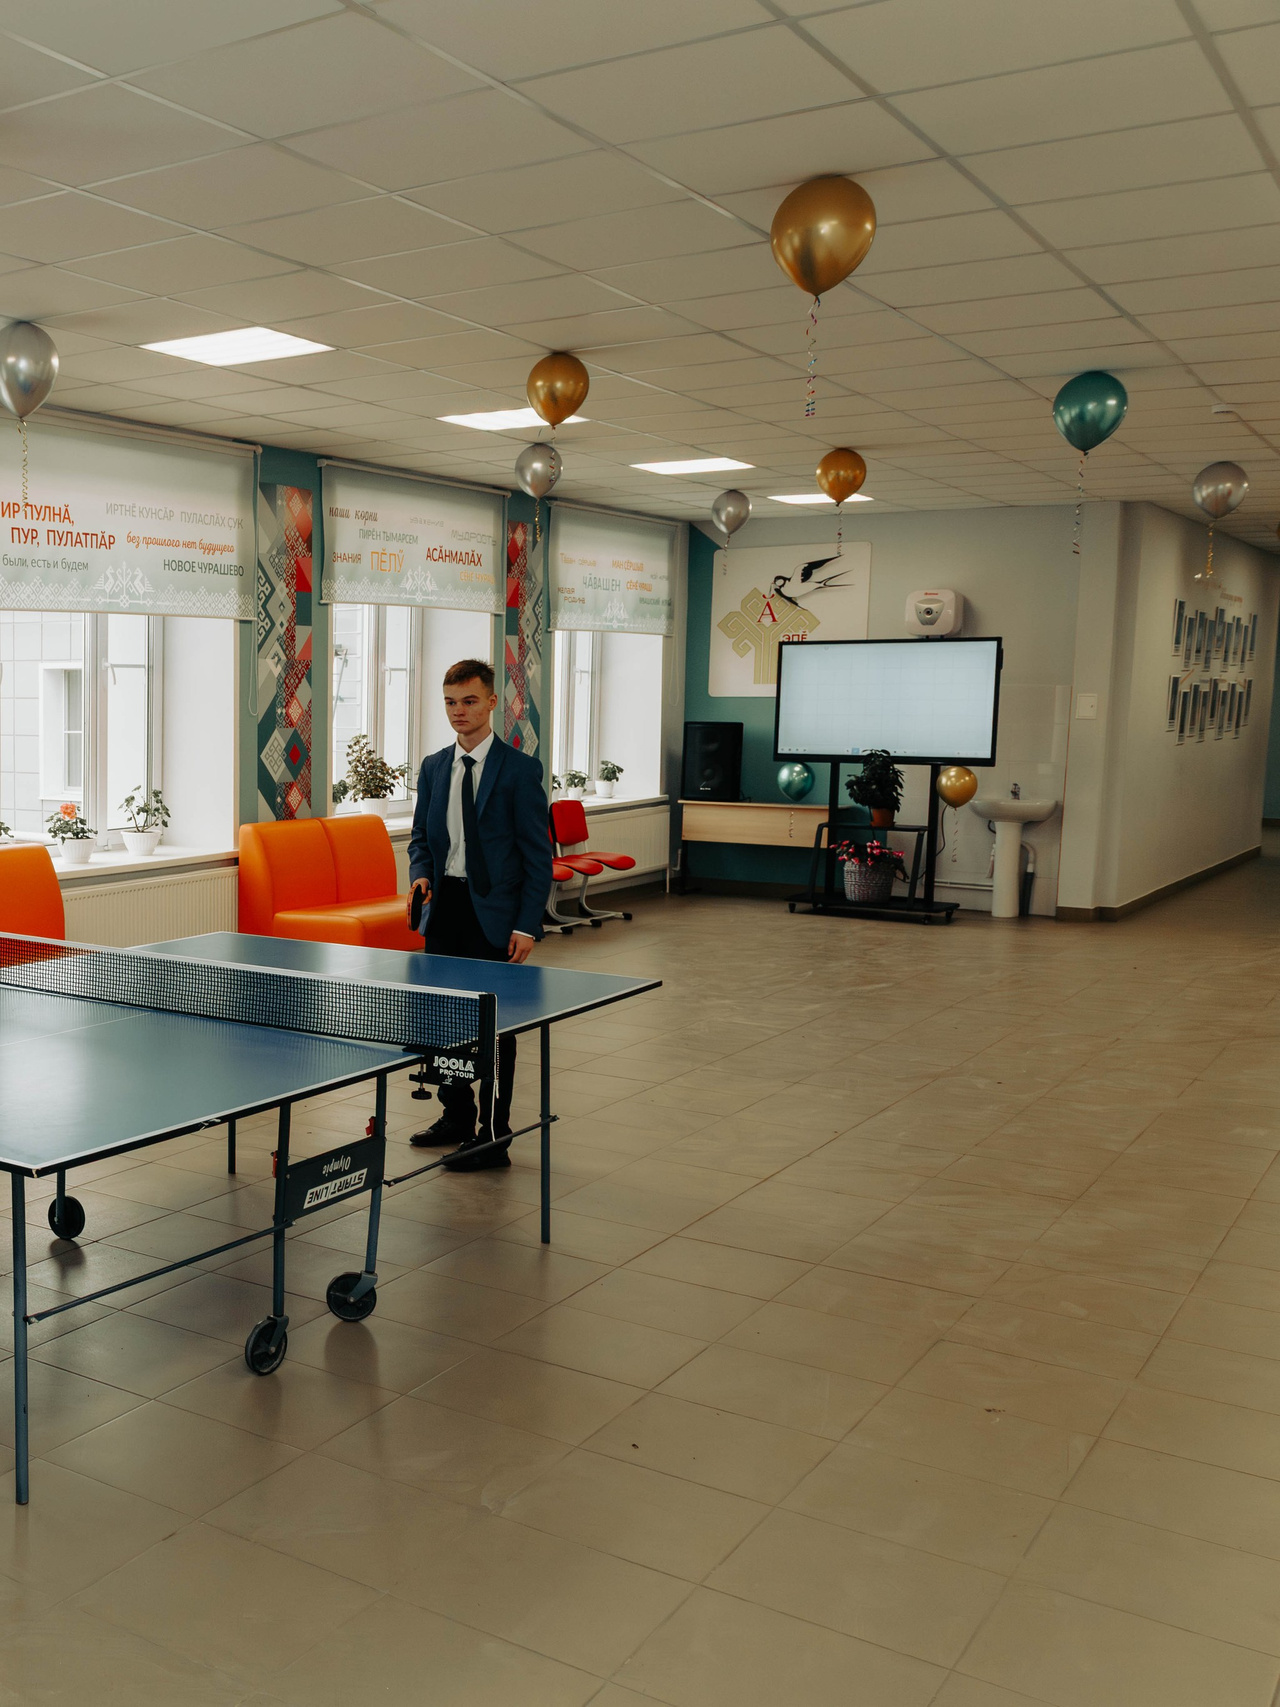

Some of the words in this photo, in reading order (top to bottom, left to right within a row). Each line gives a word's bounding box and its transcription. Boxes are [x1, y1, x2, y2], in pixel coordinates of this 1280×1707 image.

[329, 506, 350, 519] наши
[355, 510, 378, 526] корни
[11, 527, 40, 548] ПУР,
[126, 530, 140, 549] без
[142, 535, 181, 549] прошлого
[182, 540, 197, 549] нет
[198, 539, 235, 556] будущего
[382, 531, 418, 545] ТЫМАРСЕМ
[2, 554, 29, 568] были,
[31, 558, 51, 569] есть
[53, 560, 59, 569] и
[61, 558, 89, 572] будем
[332, 551, 361, 564] ЗНАНИЯ
[163, 559, 196, 573] НОВОЕ
[197, 562, 244, 577] ЧУРАШЕВО
[433, 1055, 475, 1072] JOOLA
[439, 1068, 475, 1079] PRO-TOUR
[322, 1155, 351, 1177] Olympic
